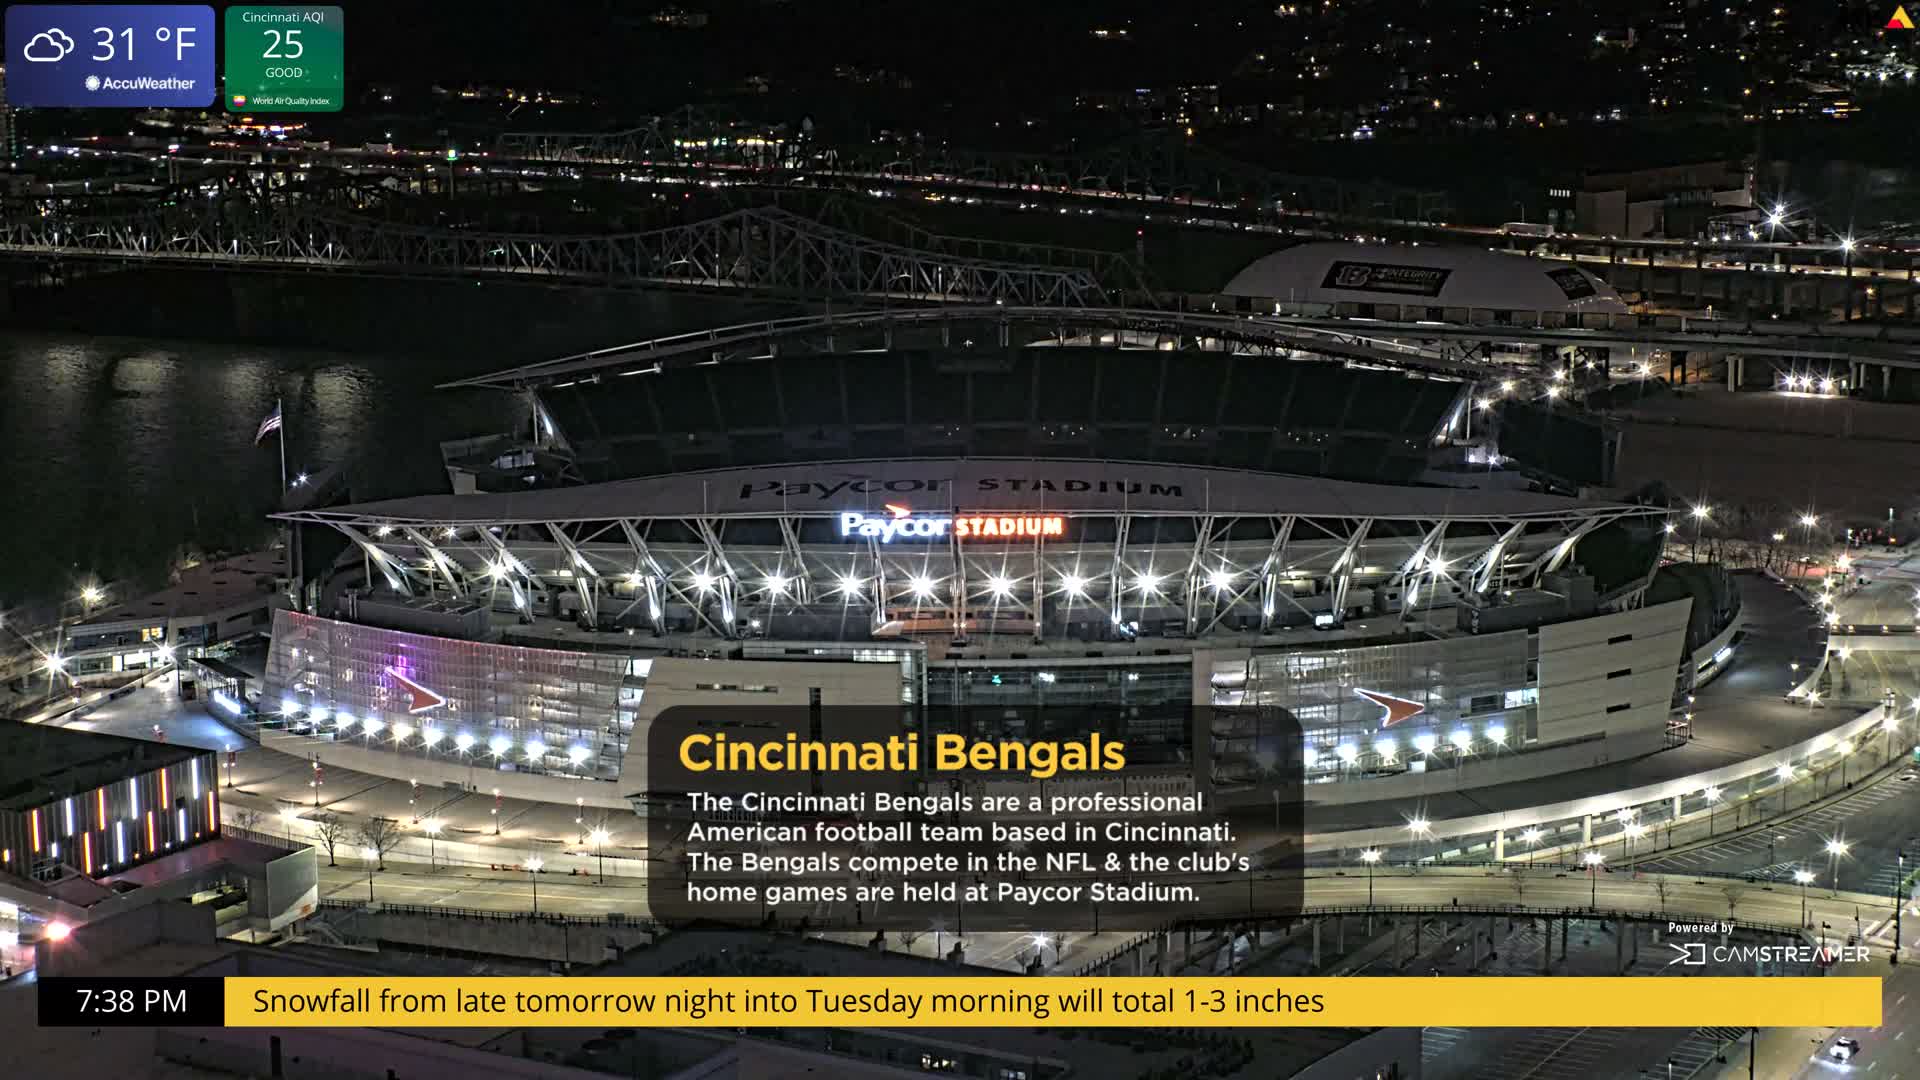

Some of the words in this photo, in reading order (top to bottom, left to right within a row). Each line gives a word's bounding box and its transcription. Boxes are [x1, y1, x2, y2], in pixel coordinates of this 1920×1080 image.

[739, 479, 951, 499] Paycor
[978, 478, 1183, 497] STADIUM
[841, 512, 953, 543] Paycor
[955, 516, 1063, 536] STADIUM
